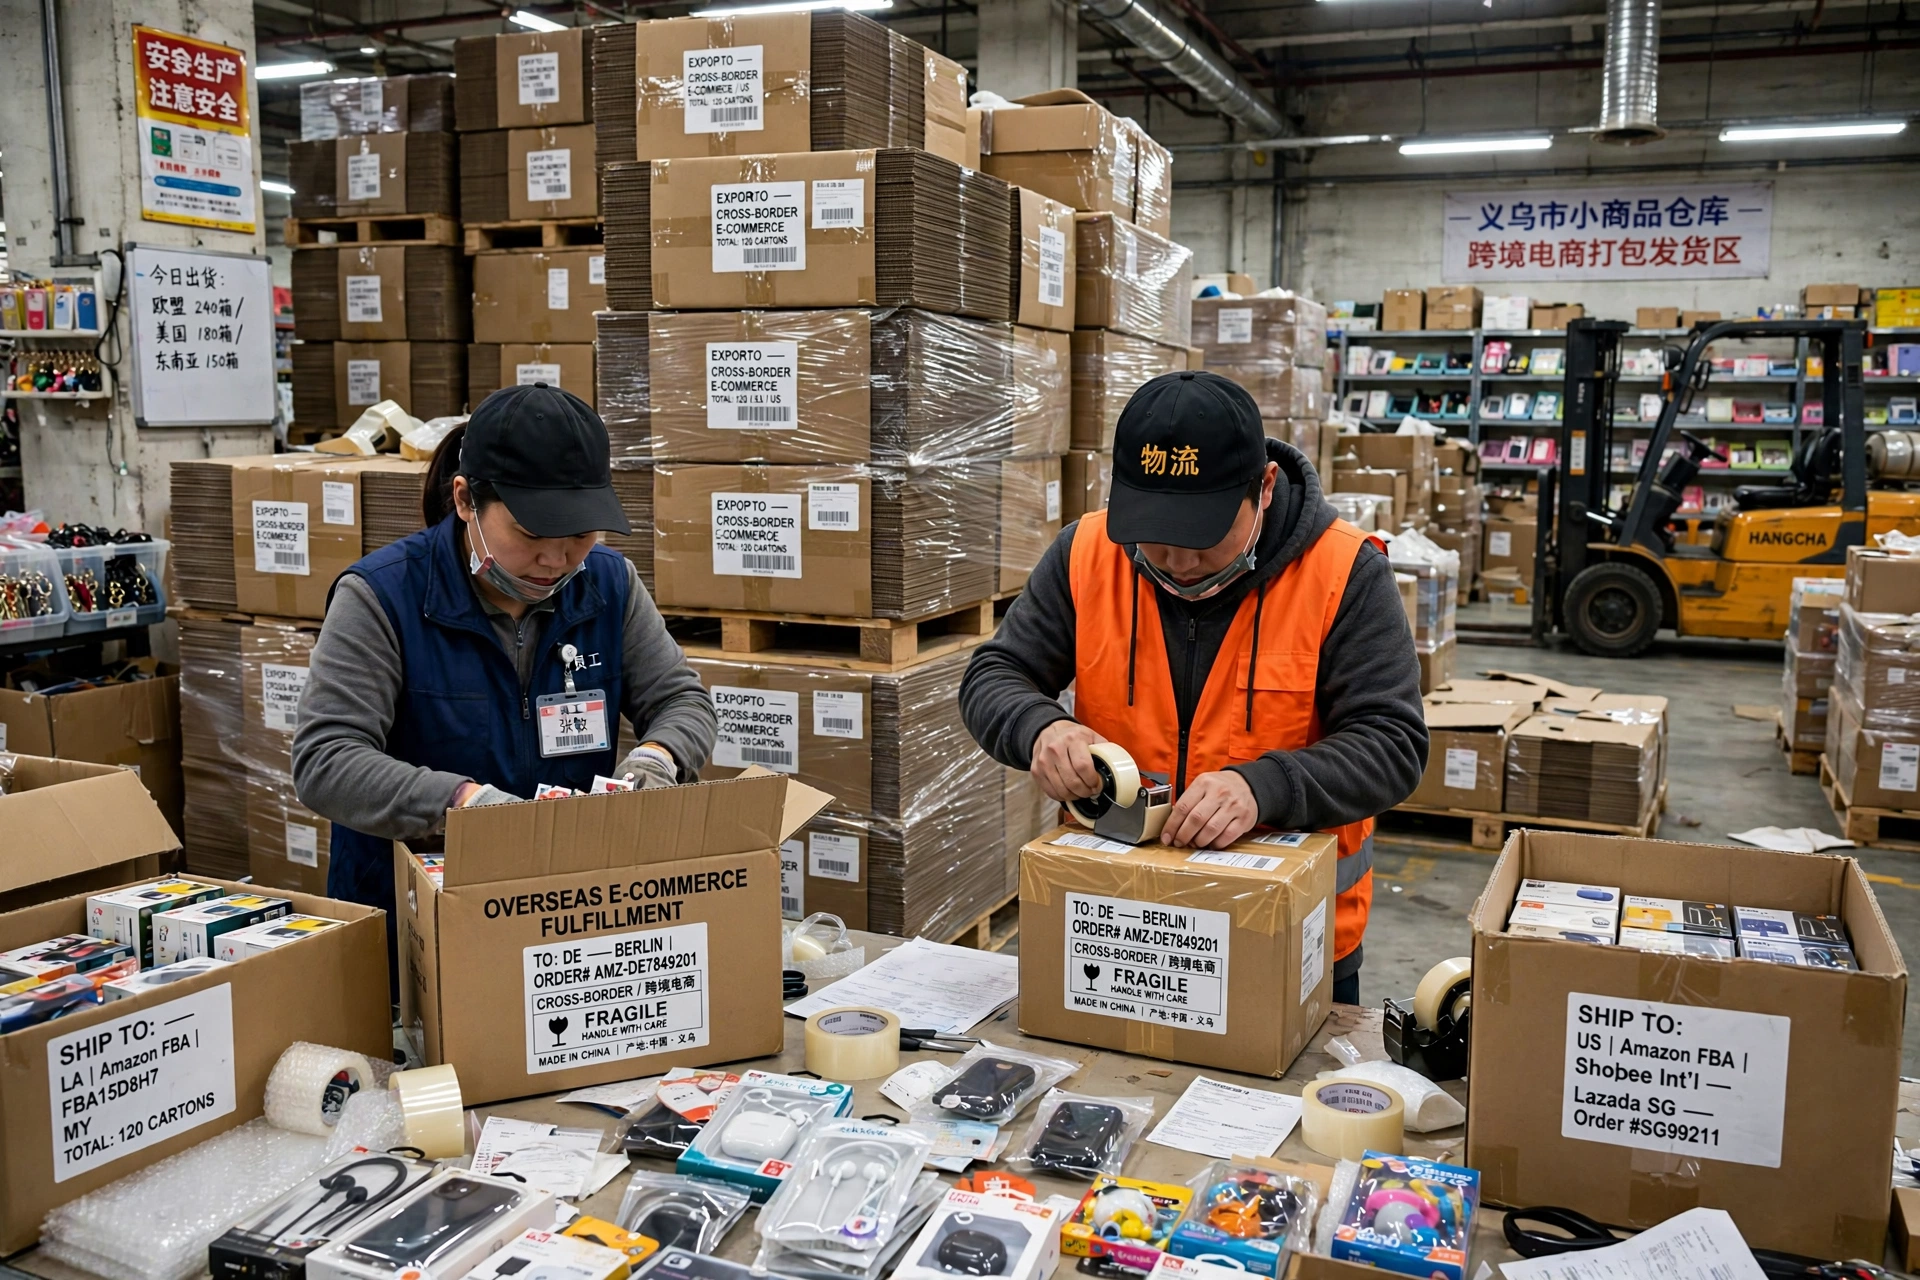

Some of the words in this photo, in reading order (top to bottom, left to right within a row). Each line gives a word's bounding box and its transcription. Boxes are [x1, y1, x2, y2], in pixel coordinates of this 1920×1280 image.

[688, 70, 758, 82] CROSS-BORDER
[149, 77, 238, 122] 注意安全
[716, 207, 798, 220] CROSS-BORDER
[1478, 196, 1730, 232] 义乌市小商品仓库
[716, 222, 784, 234] E-COMMERCE
[1468, 235, 1742, 268] 跨境电商打包发货区
[152, 296, 186, 316] 欧盟
[156, 320, 187, 344] 美国
[155, 351, 200, 371] 东南亚
[712, 350, 762, 361] EXPORTO
[712, 366, 791, 378] CROSS-BORDER
[711, 381, 778, 392] E-COMMERCE
[1141, 443, 1199, 476] 物流
[717, 516, 794, 528] CROSS-BORDER
[1749, 532, 1827, 546] HANGCHA
[484, 886, 602, 919] OVERSEAS
[609, 868, 748, 904] E-COMMERCE
[541, 901, 684, 938] FULFILLMENT
[1072, 900, 1094, 917] TO:
[1098, 904, 1114, 919] DE
[1142, 910, 1187, 930] BERLIN
[1072, 920, 1120, 939] ORDER#
[1124, 930, 1218, 953] AMZ-DE7849201
[533, 952, 558, 968] TO:
[564, 949, 582, 964] DE
[615, 937, 663, 958] BERLIN
[1074, 942, 1158, 966] CROSS-BORDER
[534, 967, 590, 988] ORDER#
[594, 952, 696, 981] AMZ-DE7849201
[1114, 968, 1188, 993] FRAGILE
[536, 985, 633, 1010] CROSS-BORDER
[1074, 996, 1098, 1008] MADE
[1100, 1000, 1108, 1010] IN
[1110, 1002, 1136, 1014] CHINA
[1144, 990, 1164, 1000] WITH
[1166, 994, 1188, 1004] CARE
[585, 1000, 668, 1028] FRAGILE
[1578, 1004, 1634, 1028] SHIP
[1642, 1012, 1682, 1036] TO:
[60, 1032, 112, 1066] SHIP
[118, 1020, 154, 1045] TO:
[582, 1026, 618, 1041] HANDLE
[620, 1022, 642, 1035] WITH
[644, 1019, 668, 1031] CARE
[61, 1072, 84, 1093] LA
[100, 1048, 158, 1080] Amazon
[162, 1034, 190, 1056] FBA
[538, 1055, 566, 1068] MADE
[569, 1053, 578, 1062] IN
[581, 1047, 610, 1061] CHINA
[1577, 1032, 1601, 1051] US
[1620, 1038, 1690, 1063] Amazon
[1698, 1048, 1735, 1069] FBA
[62, 1068, 158, 1118] FBA15D8H7
[1574, 1086, 1640, 1112] Lazada
[1648, 1097, 1676, 1116] SG
[64, 1135, 114, 1164] TOTAL:
[119, 1121, 143, 1143] 120
[148, 1092, 215, 1130] CARTONS
[64, 1117, 92, 1142] MY
[1574, 1109, 1624, 1132] Order
[1629, 1117, 1719, 1146] #SG99211
